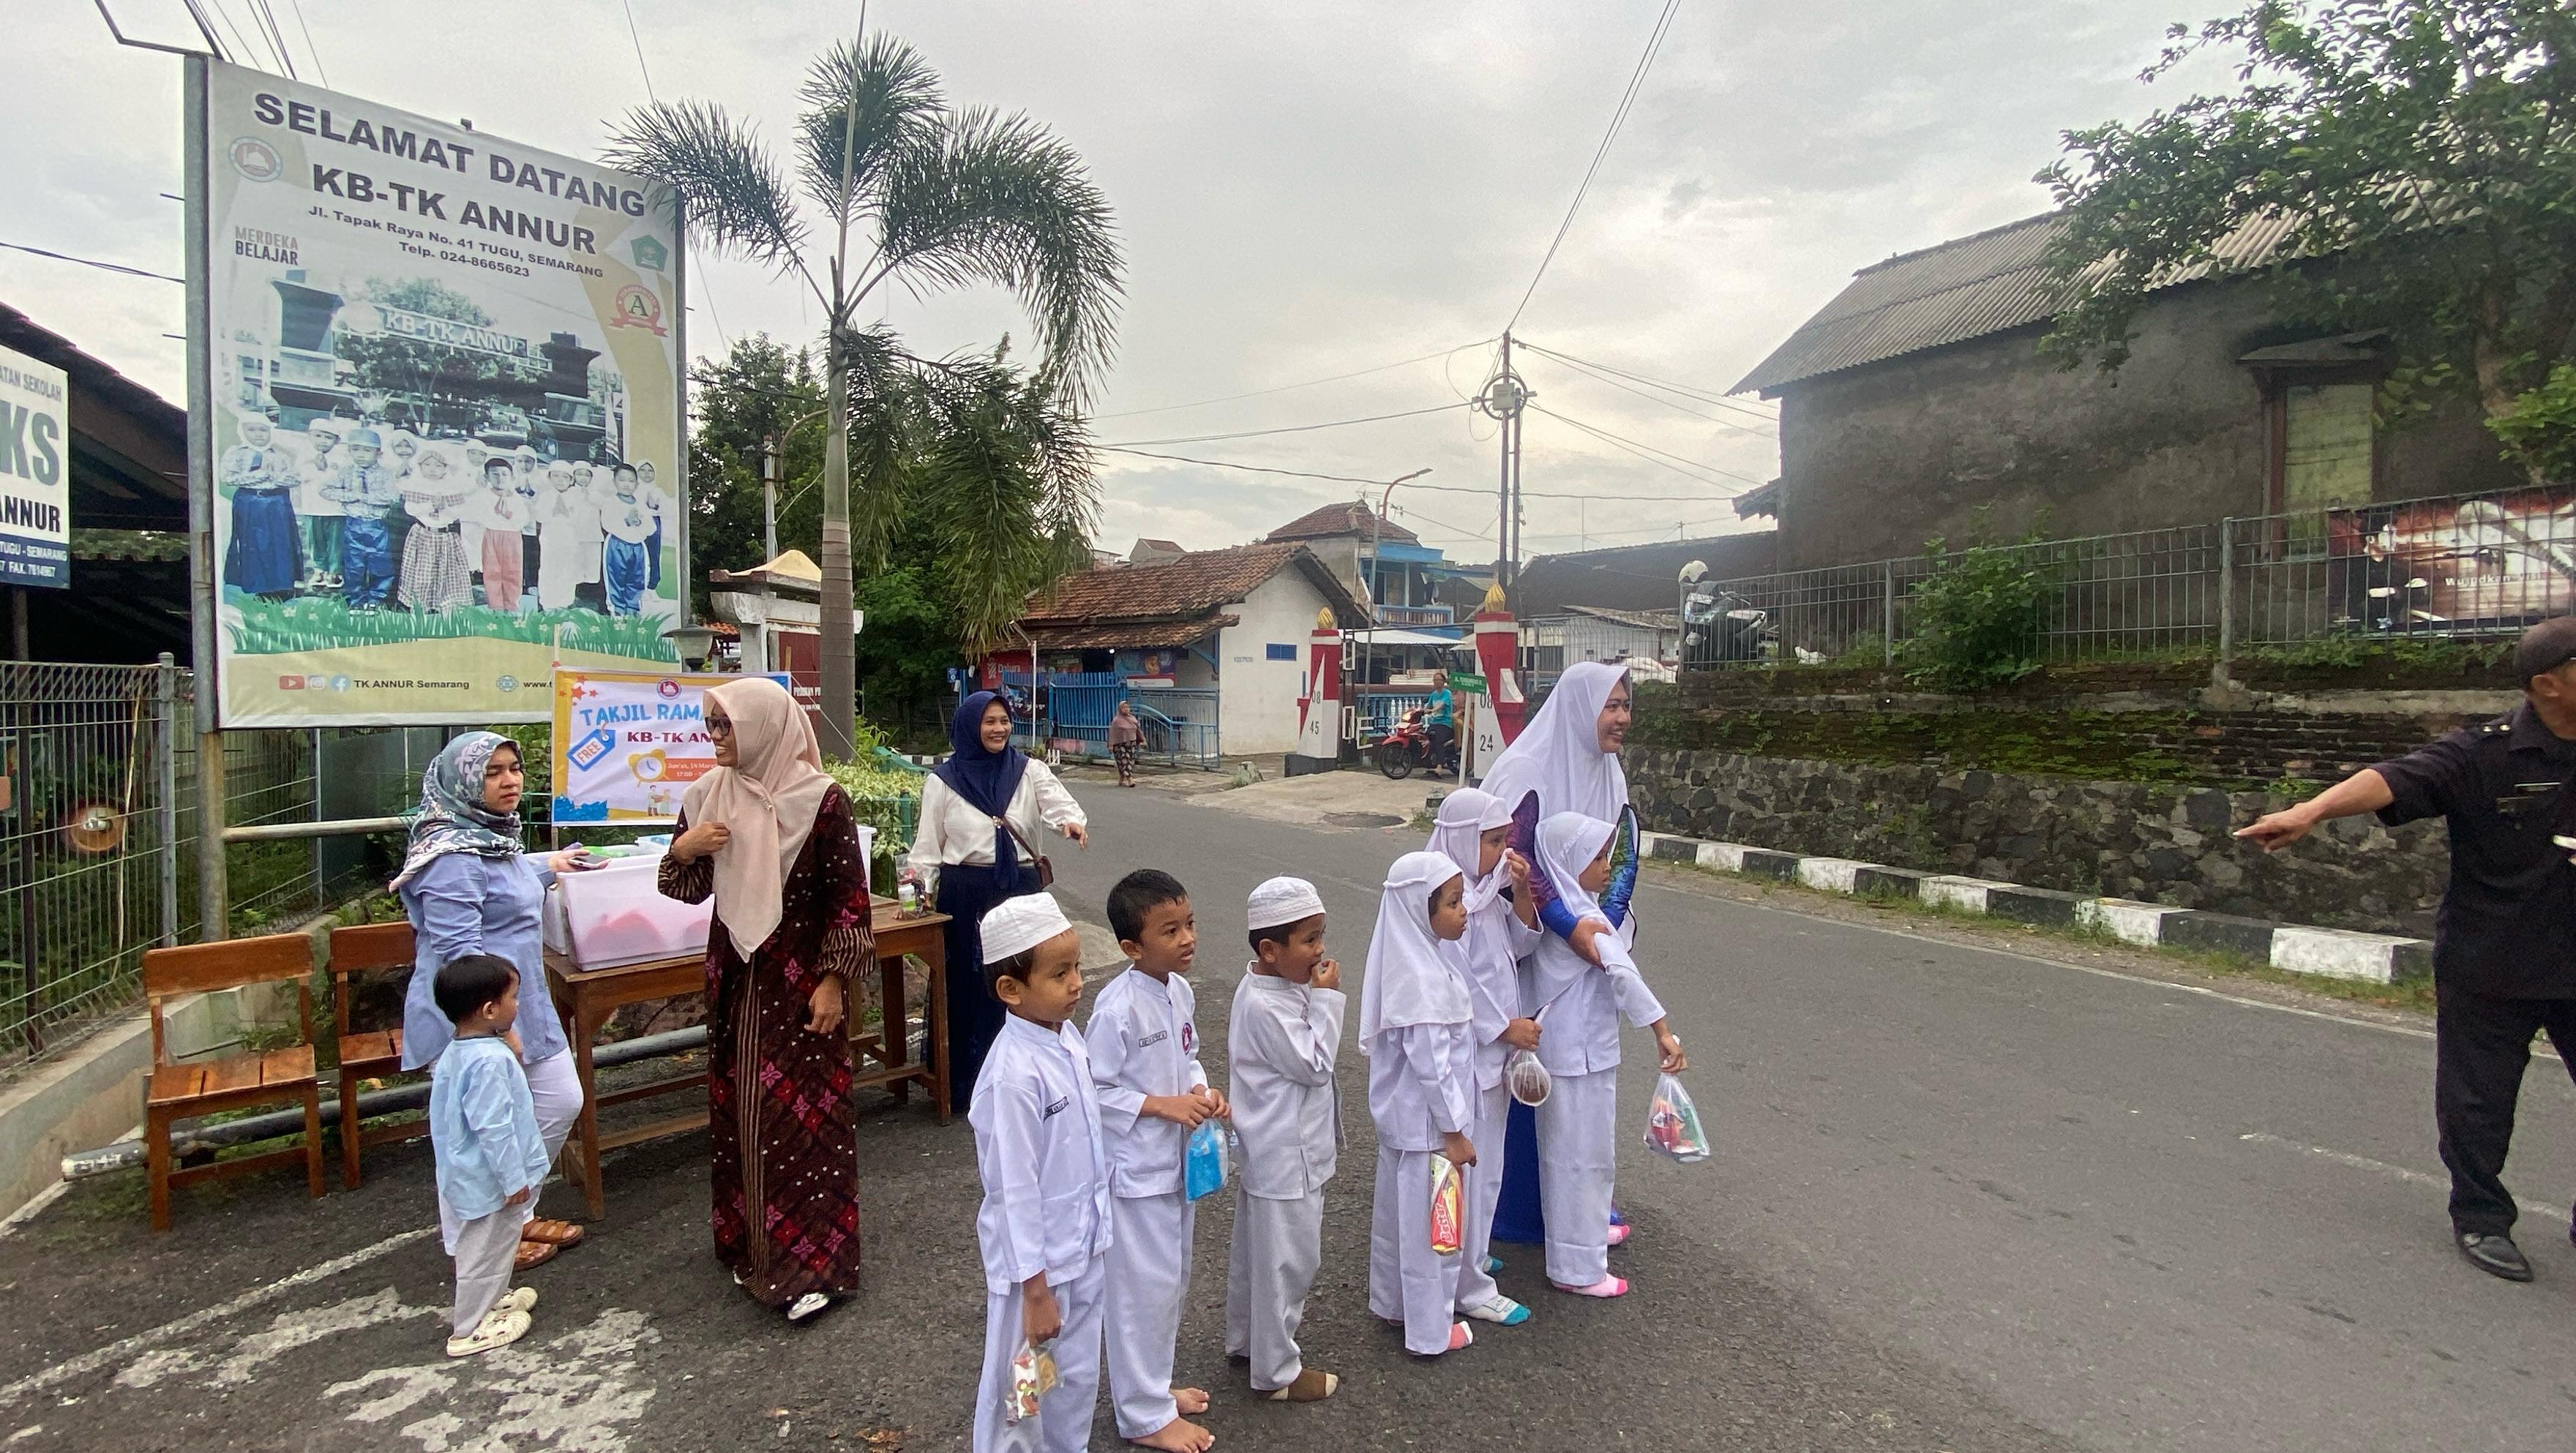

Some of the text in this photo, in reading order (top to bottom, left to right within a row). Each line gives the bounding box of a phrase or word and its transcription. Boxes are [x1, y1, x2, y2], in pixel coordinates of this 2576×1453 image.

[254, 93, 474, 173] SELAMAT
[490, 154, 645, 217] DATANG
[313, 163, 596, 255] KB-TK ANNUR
[235, 225, 298, 250] MERDEKA
[333, 210, 381, 231] Tapak
[387, 222, 423, 239] Raya
[429, 230, 453, 245] No.
[457, 239, 473, 249] 41
[479, 243, 523, 262] TUGU,
[528, 253, 603, 278] SEMARANG
[235, 240, 298, 266] BELAJAR
[399, 241, 530, 277] Telp. 024-8665623
[628, 295, 649, 317] A
[23, 374, 61, 402] SEKOLAH
[353, 680, 370, 688] TK
[372, 680, 413, 688] ANNUR
[417, 680, 470, 690] Semarang
[580, 703, 704, 726] TAKJIL RAM
[627, 732, 684, 743] KB-TK
[1310, 721, 1319, 735] 45
[576, 740, 602, 763] FREE
[1480, 735, 1494, 751] 24
